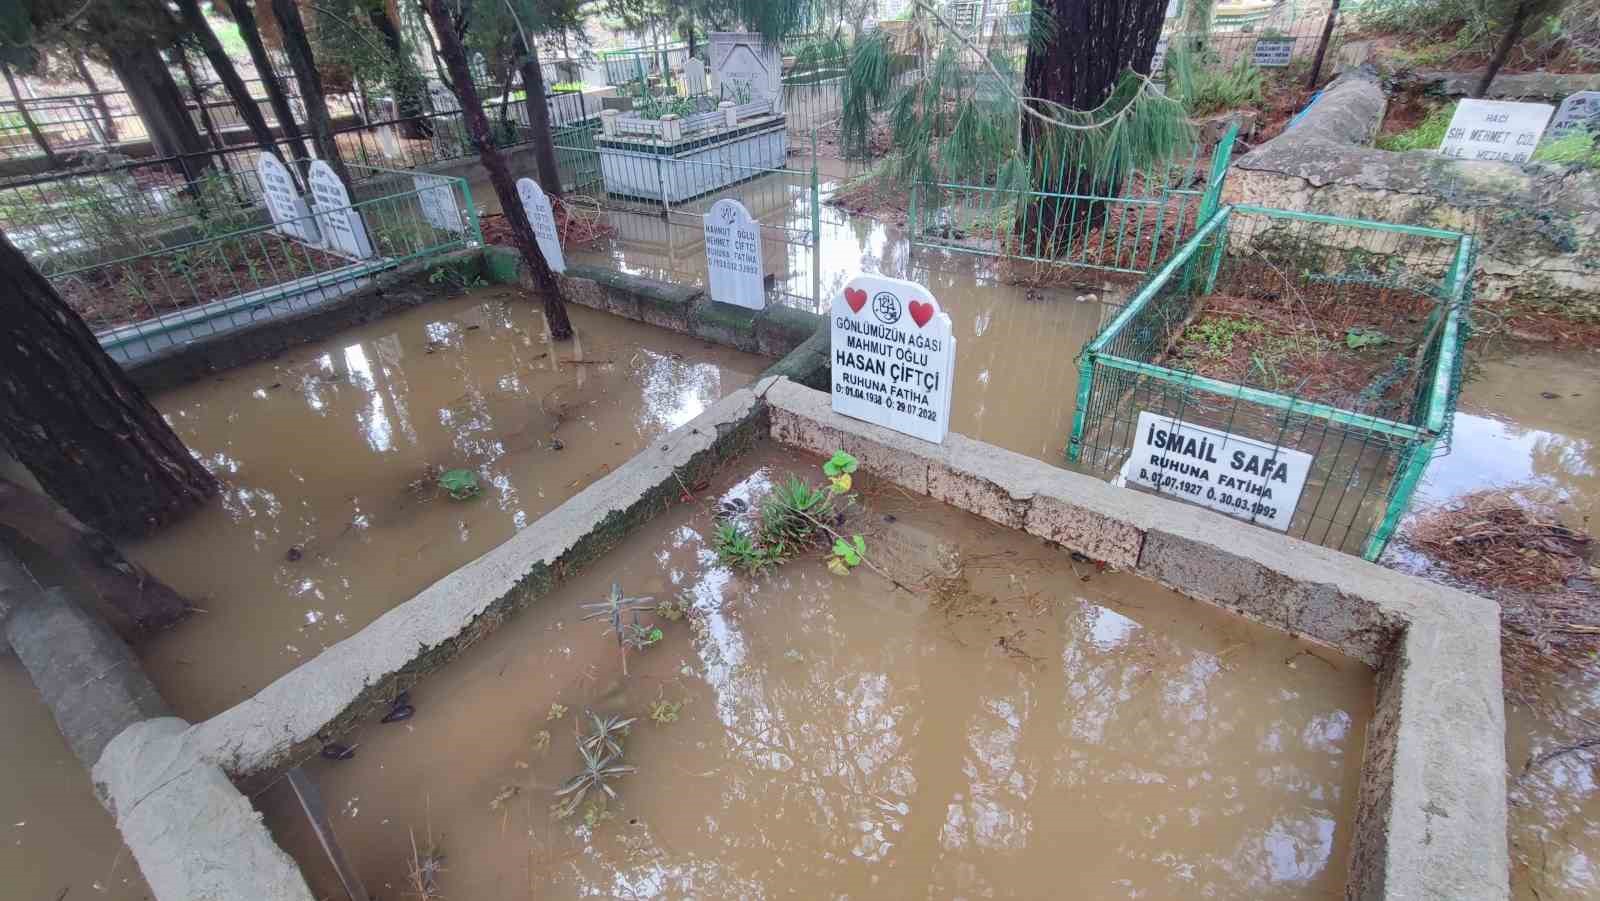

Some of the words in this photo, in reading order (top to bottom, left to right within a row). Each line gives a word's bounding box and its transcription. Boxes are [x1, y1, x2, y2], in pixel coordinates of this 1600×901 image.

[836, 316, 906, 345] GÖNLÜMÜZÜN
[908, 333, 942, 353] AĞASI
[847, 335, 893, 358] MAHMUT
[896, 345, 928, 367] OĞLU
[836, 349, 886, 377] HASAN
[890, 362, 940, 394] ÇİFTÇİ
[842, 372, 887, 394] RUHUNA
[890, 384, 929, 406] FATİHA
[845, 386, 883, 406] 01.04.1938
[896, 400, 937, 422] 29.07.2022
[1147, 422, 1218, 464] İSMAİL
[1230, 450, 1289, 484] SAFA
[1139, 468, 1150, 482] D.
[1150, 473, 1203, 497] 07.07.1927
[1206, 488, 1217, 502] Ö.
[1219, 491, 1278, 519] 30.03.1992
[1150, 454, 1210, 482] RUHUNA
[1218, 473, 1273, 500] FATİHA
